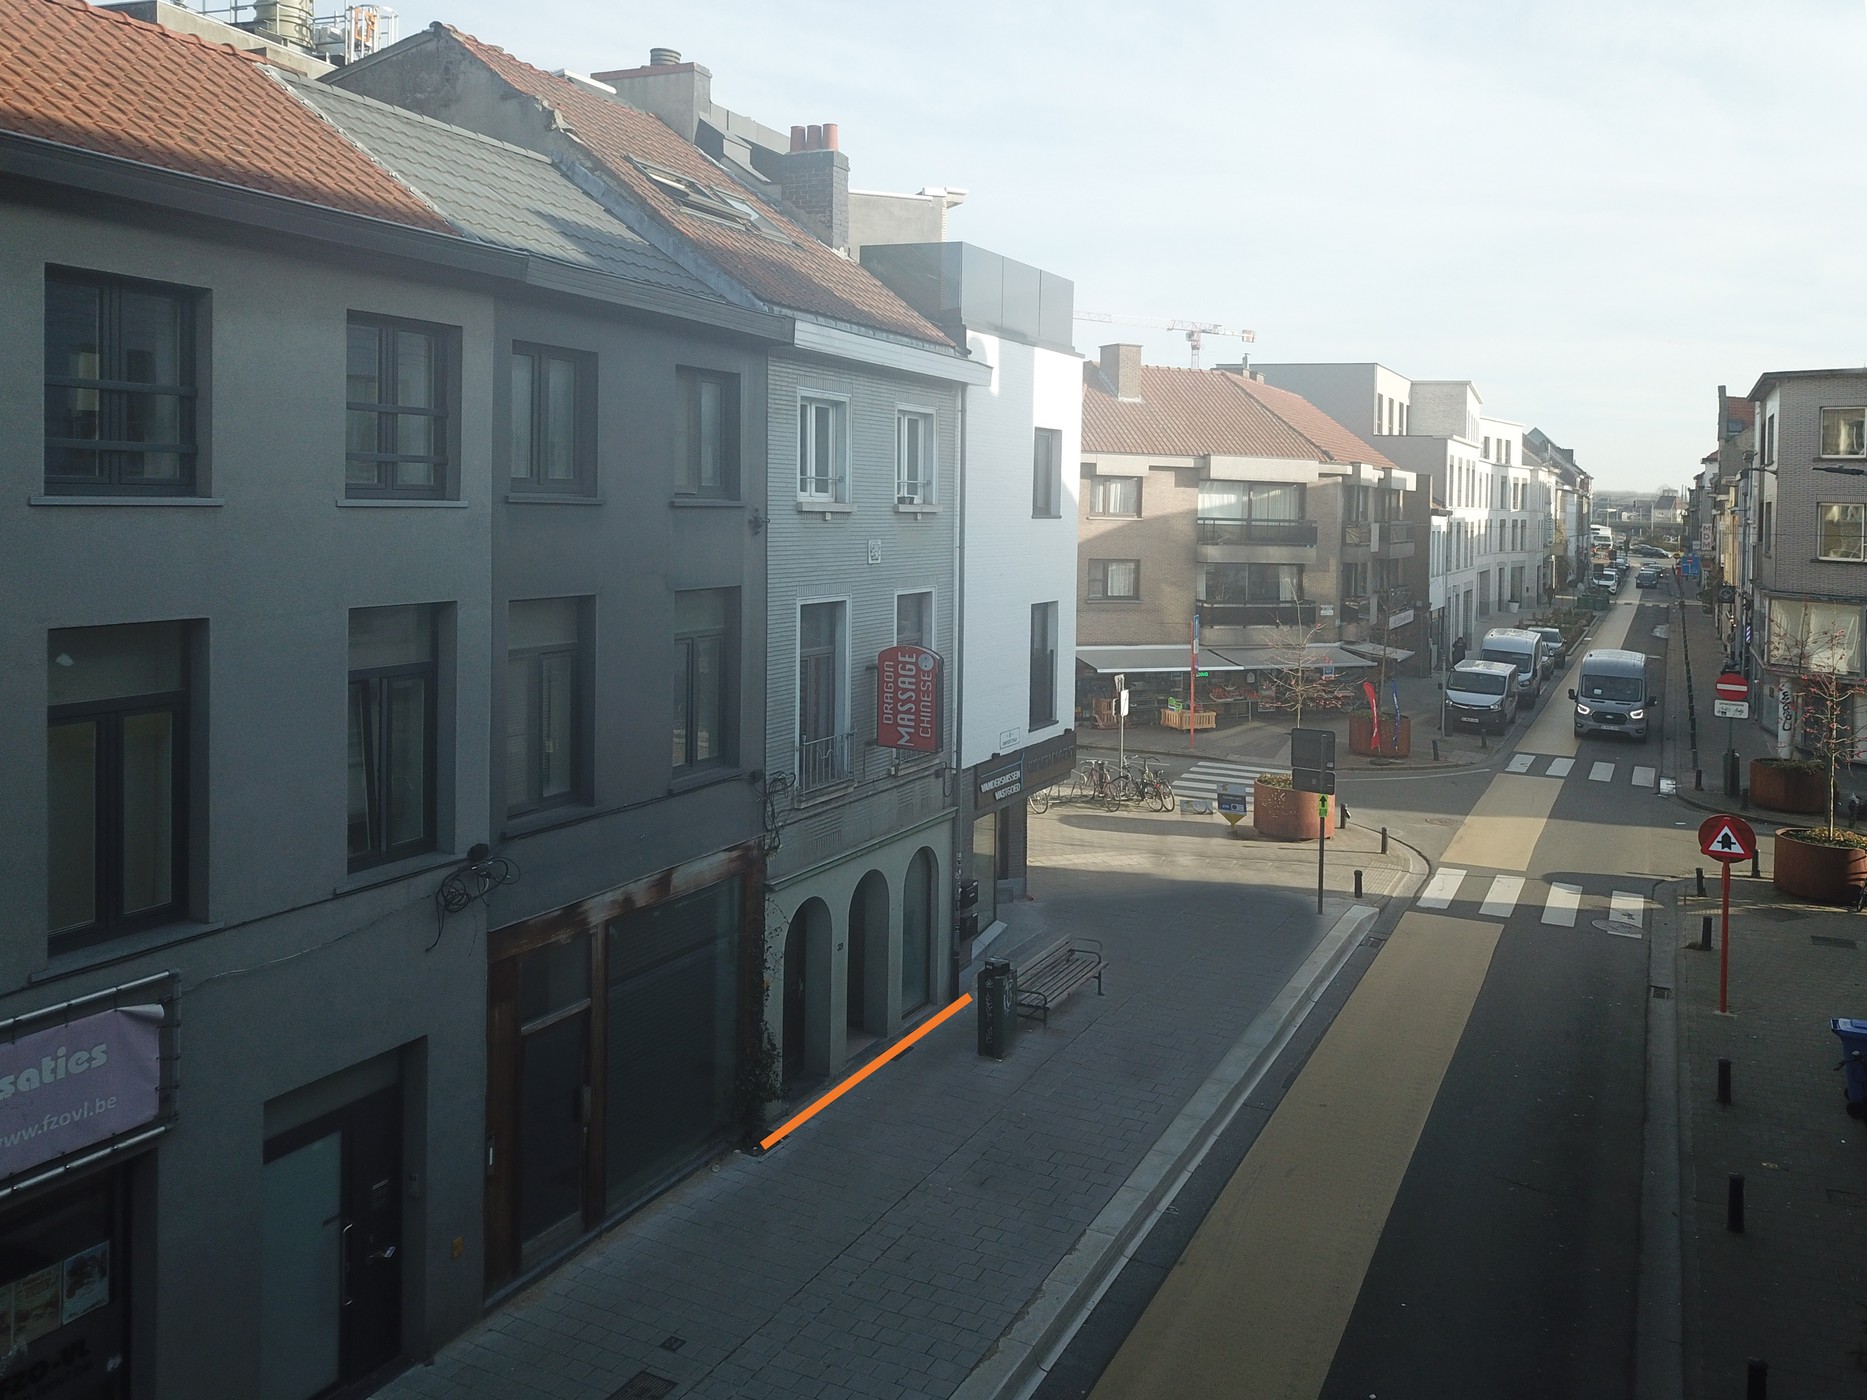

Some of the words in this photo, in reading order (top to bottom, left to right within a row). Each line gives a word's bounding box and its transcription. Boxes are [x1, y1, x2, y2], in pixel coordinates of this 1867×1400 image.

[883, 661, 894, 724] DRAGON
[896, 651, 916, 747] MASSAGE
[919, 671, 932, 737] CHINESE
